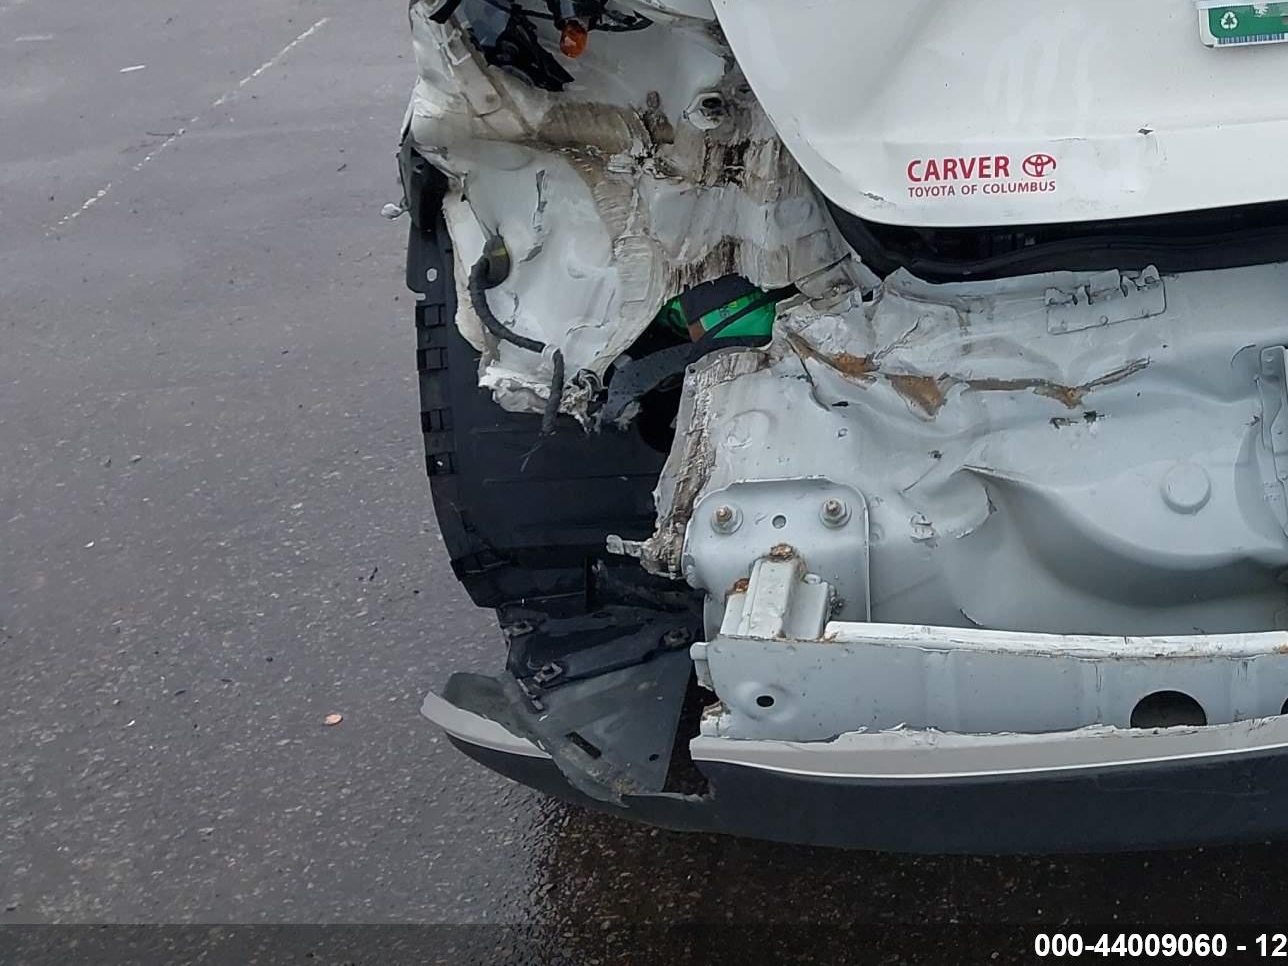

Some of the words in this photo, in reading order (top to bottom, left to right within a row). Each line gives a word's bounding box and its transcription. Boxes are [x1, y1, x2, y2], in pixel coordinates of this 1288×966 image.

[907, 155, 1010, 182] CARVER
[907, 185, 955, 198] TOYOTA
[961, 184, 978, 196] OF
[982, 180, 1056, 194] COLUMBUS
